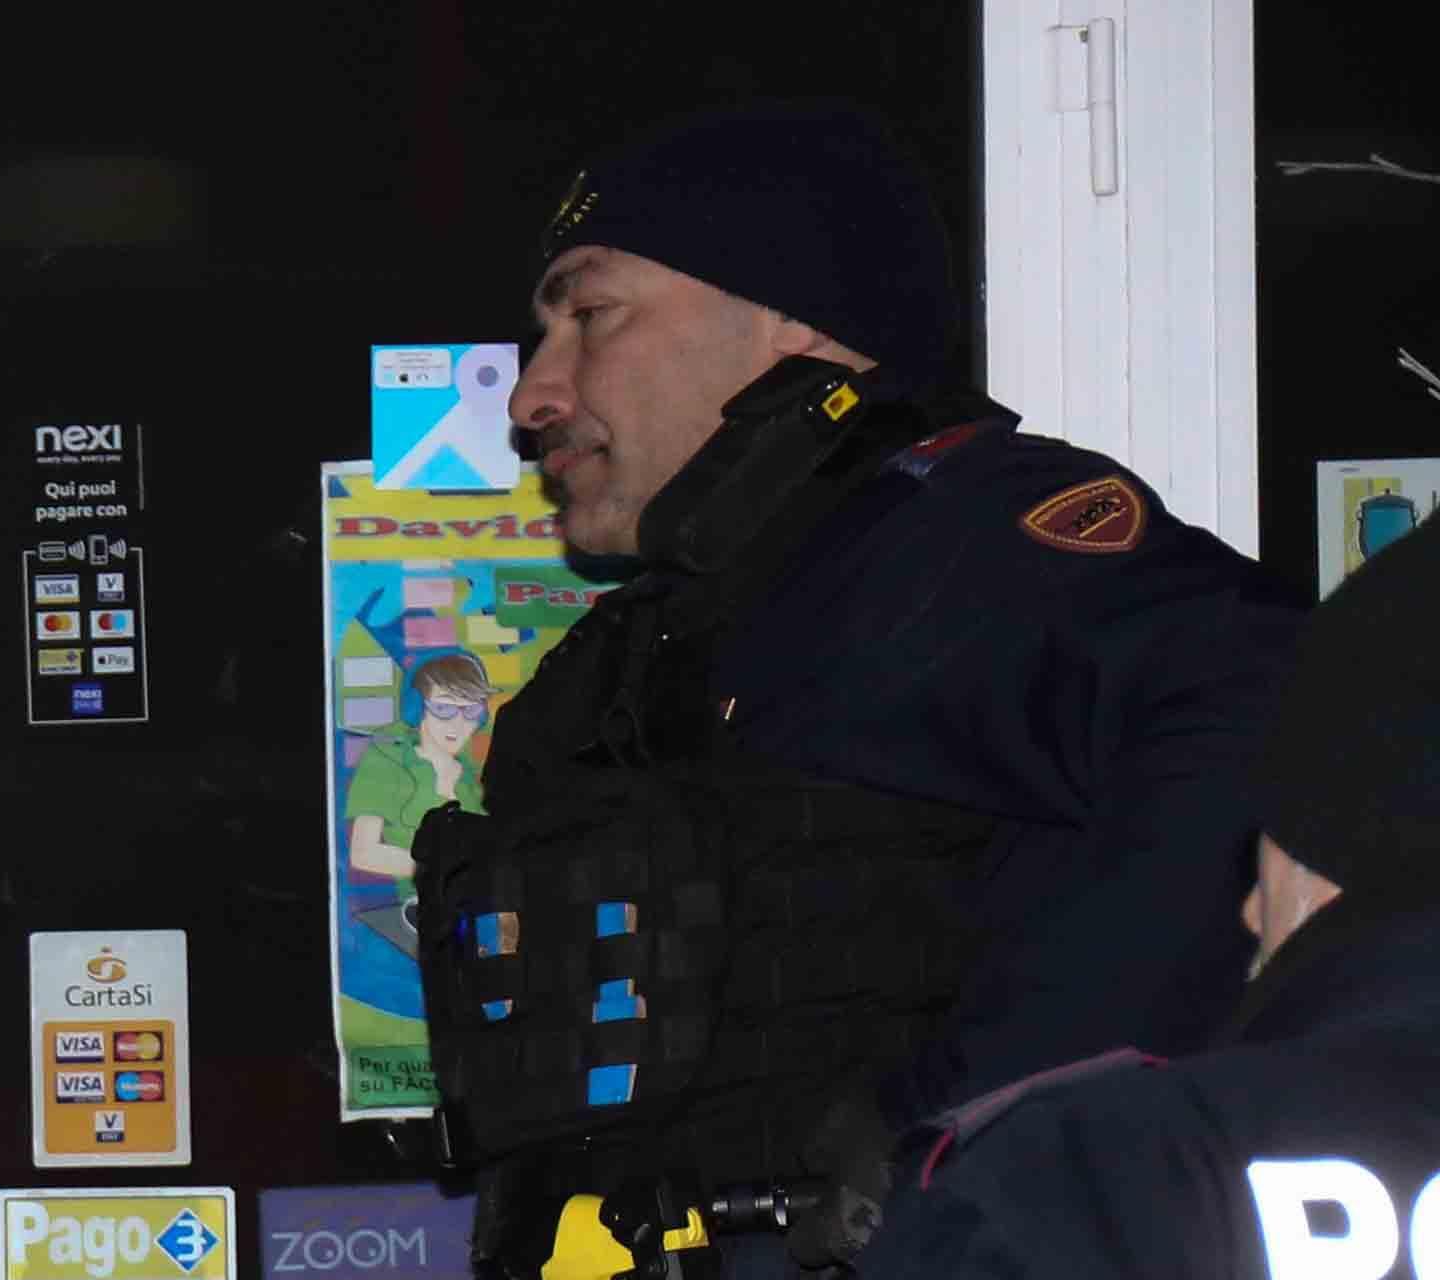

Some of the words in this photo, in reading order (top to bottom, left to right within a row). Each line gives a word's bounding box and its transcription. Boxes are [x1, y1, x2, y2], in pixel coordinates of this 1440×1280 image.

[35, 424, 122, 452] nexi
[45, 481, 75, 499] Qui
[79, 480, 117, 500] puoi
[36, 504, 93, 522] pagare
[96, 504, 128, 517] con
[65, 983, 153, 1007] CartaSi
[60, 1036, 103, 1052] VISA
[60, 1076, 103, 1092] VISA
[10, 1201, 151, 1278] Pago
[271, 1227, 427, 1272] ZOOM
